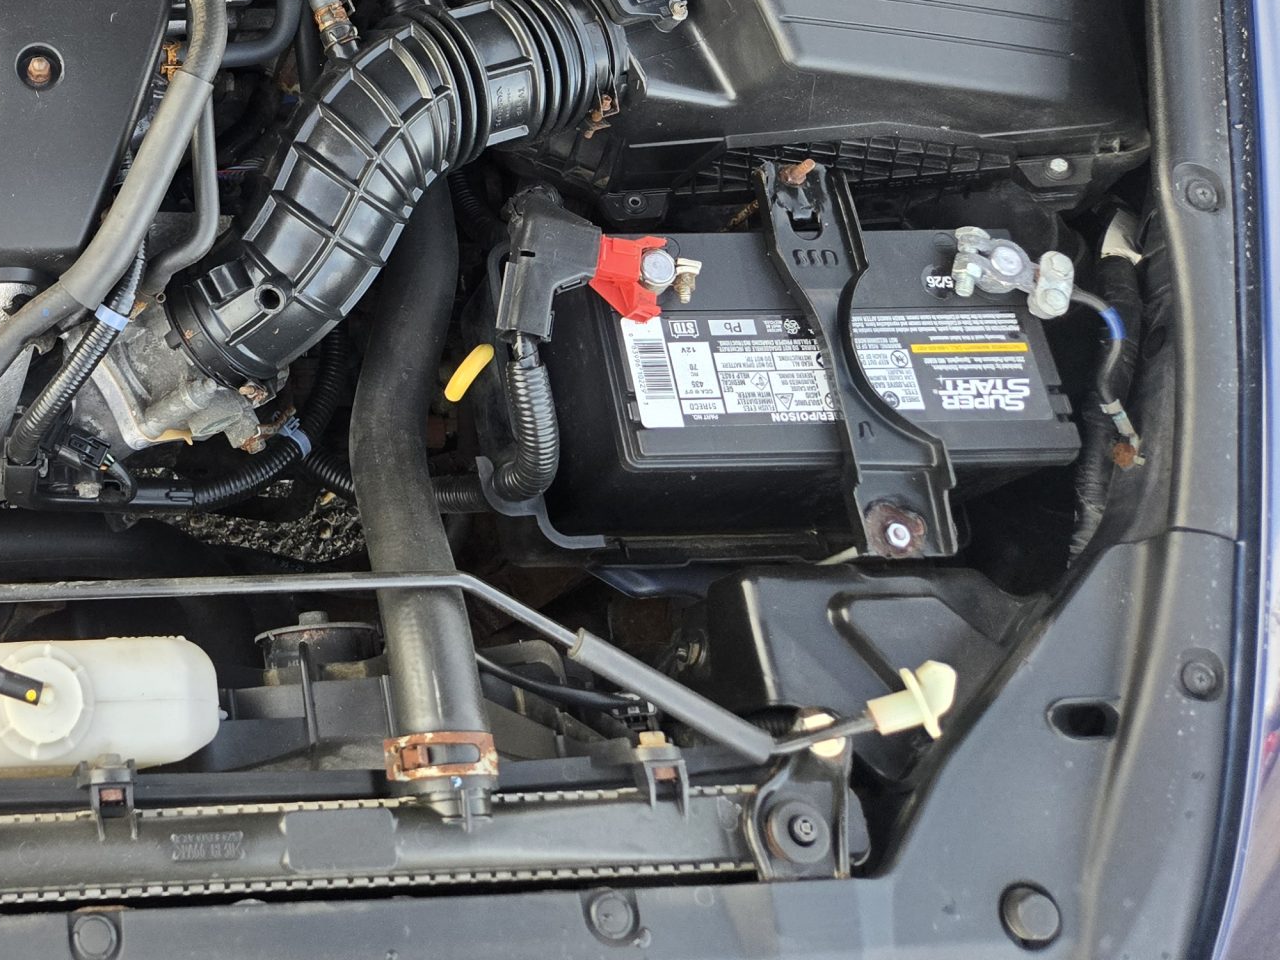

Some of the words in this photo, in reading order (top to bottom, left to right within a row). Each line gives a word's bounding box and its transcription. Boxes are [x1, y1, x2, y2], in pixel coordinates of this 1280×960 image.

[926, 275, 954, 288] 5/26
[672, 322, 695, 332] STD
[723, 322, 741, 332] Pb
[937, 378, 1030, 396] START
[941, 395, 1025, 411] SUPER
